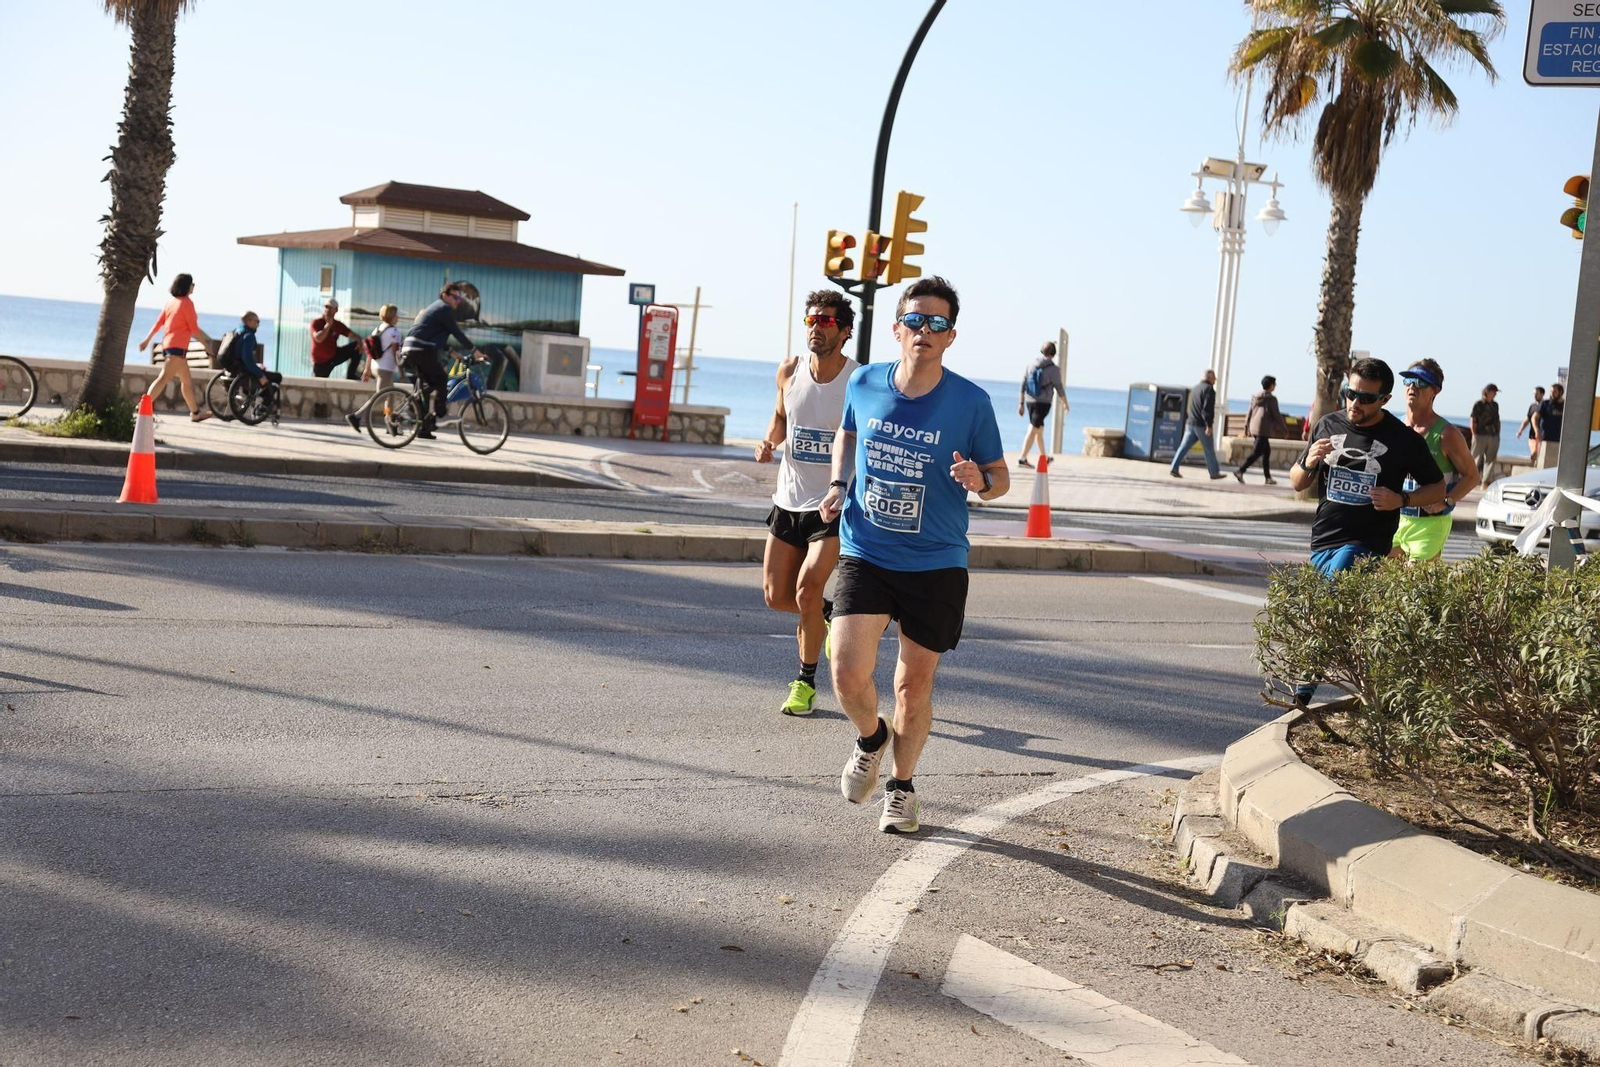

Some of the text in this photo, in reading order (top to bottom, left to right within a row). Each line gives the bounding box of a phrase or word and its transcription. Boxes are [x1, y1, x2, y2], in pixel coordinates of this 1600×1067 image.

[1569, 26, 1595, 39] FIN
[1542, 43, 1600, 56] ESTACI
[867, 417, 941, 445] mayoral
[795, 440, 829, 453] 2211
[863, 438, 931, 463] RUNNING
[867, 458, 924, 478] FRIENDS
[868, 449, 924, 469] MAKES
[1333, 479, 1370, 495] 2038
[867, 494, 914, 516] 2062
